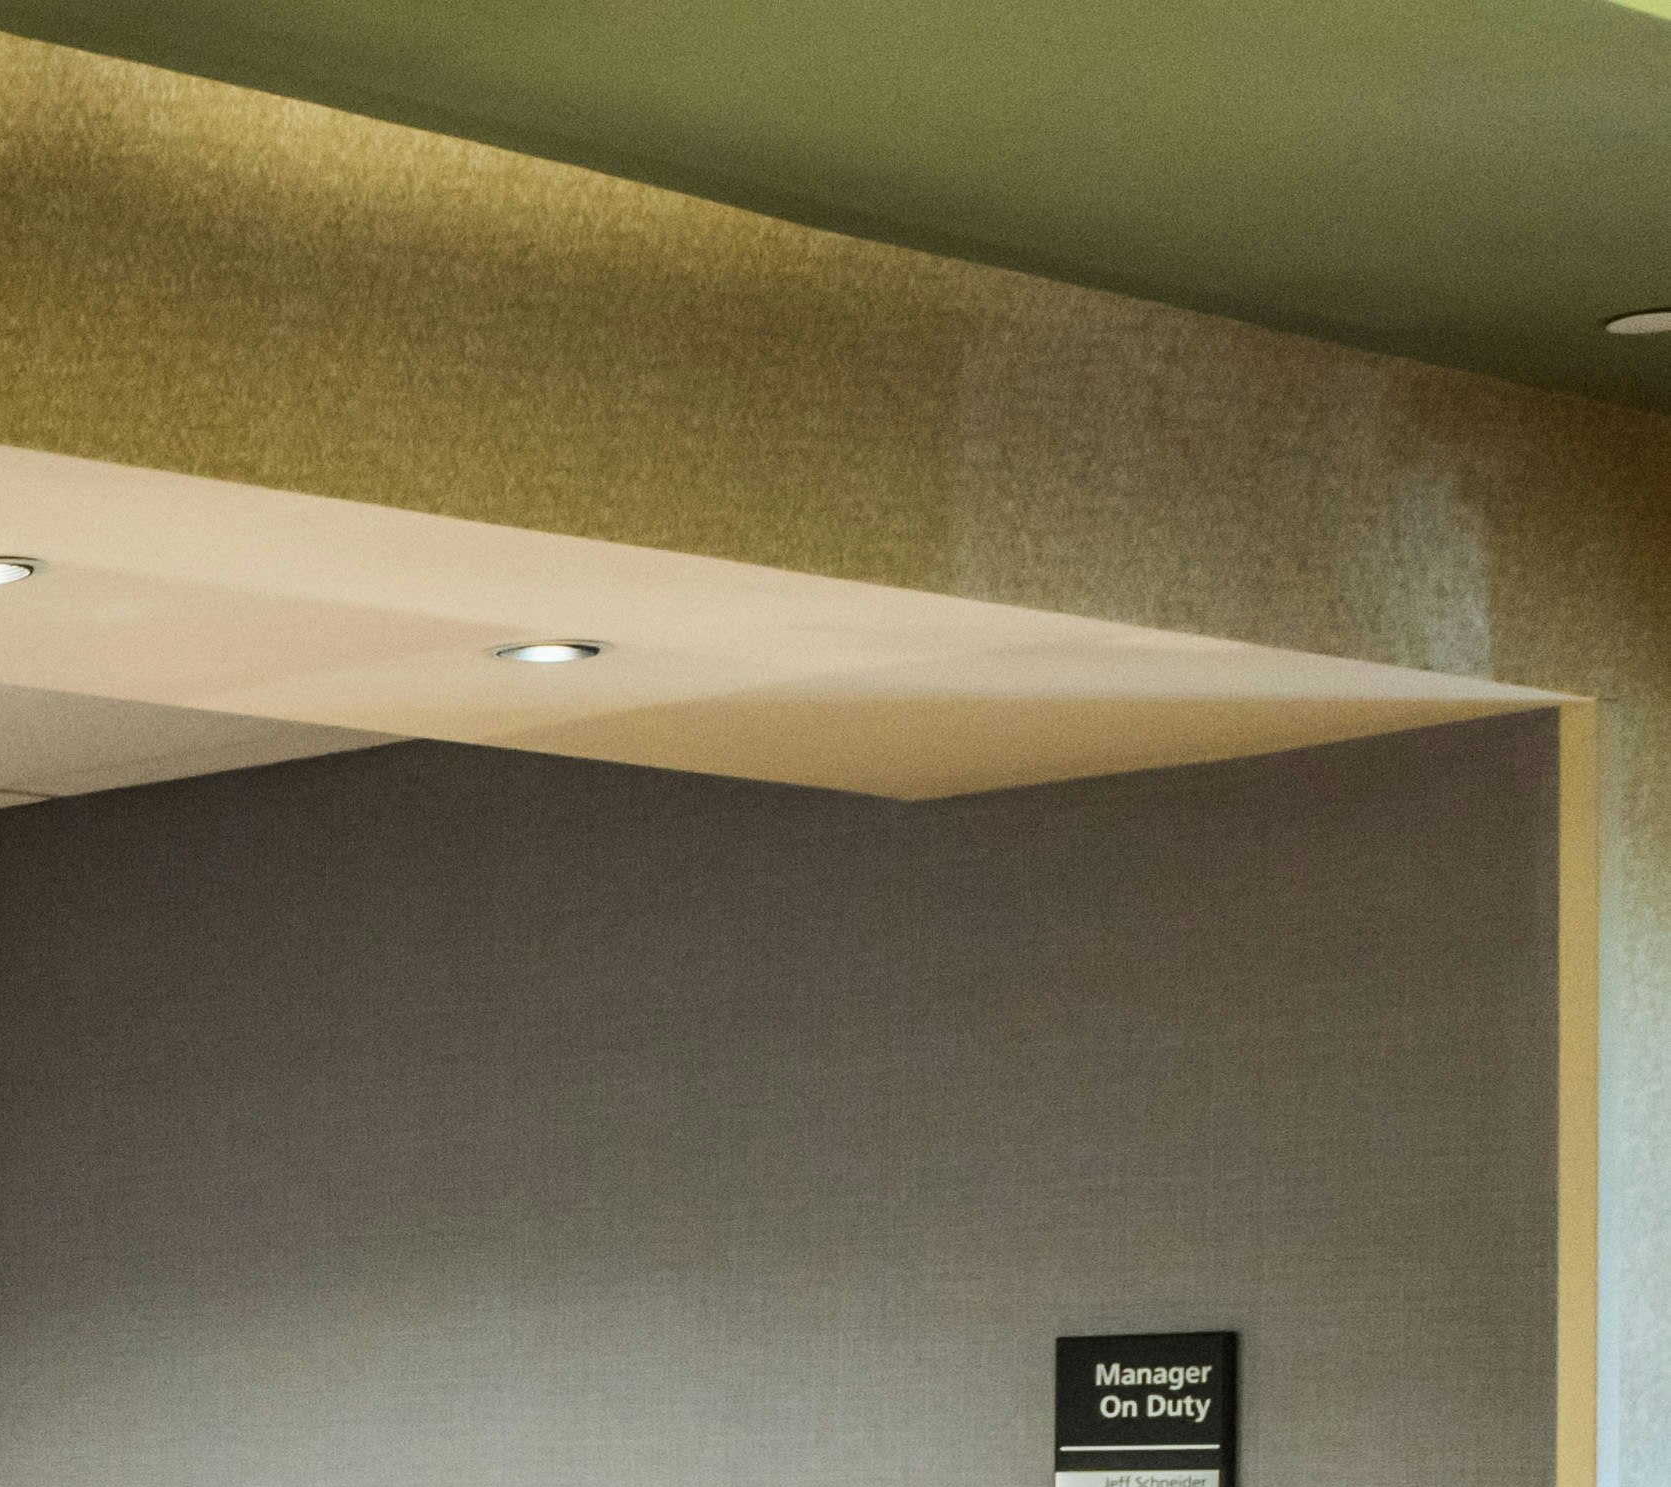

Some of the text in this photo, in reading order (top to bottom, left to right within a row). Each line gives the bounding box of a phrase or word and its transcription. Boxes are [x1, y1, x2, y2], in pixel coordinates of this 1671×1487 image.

[1095, 1363, 1212, 1390] Manager
[1100, 1394, 1211, 1423] On Duty
